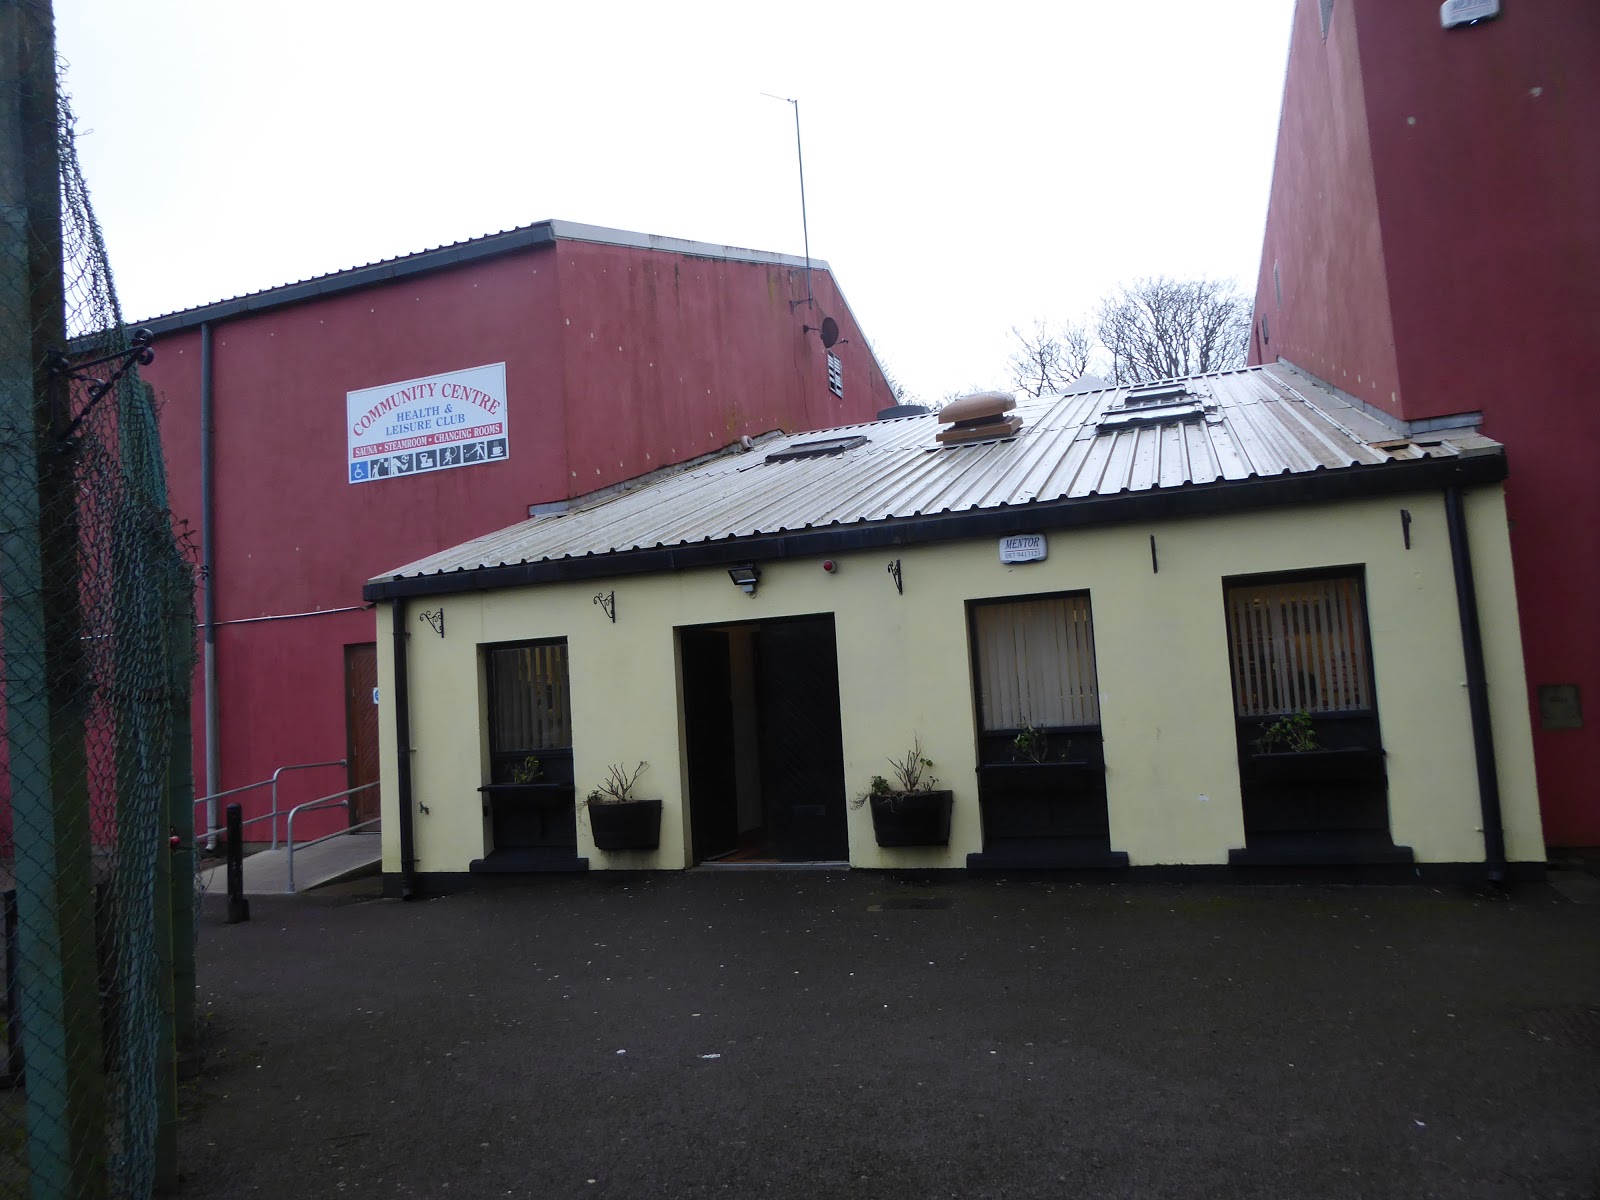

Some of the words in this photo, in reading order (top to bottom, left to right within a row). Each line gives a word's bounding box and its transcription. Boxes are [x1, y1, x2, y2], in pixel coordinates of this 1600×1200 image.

[353, 383, 437, 437] COMMUNITY
[441, 383, 501, 416] CENTRE
[396, 405, 440, 422] HEALTH
[444, 403, 453, 413] &
[386, 419, 432, 436] LEISURE
[436, 413, 466, 427] CLUB
[355, 445, 378, 457] SAUNA
[384, 436, 428, 451] STEAMROOM
[434, 428, 472, 444] CHANGING
[474, 423, 500, 437] ROOMS
[1005, 537, 1040, 549] MENTOR
